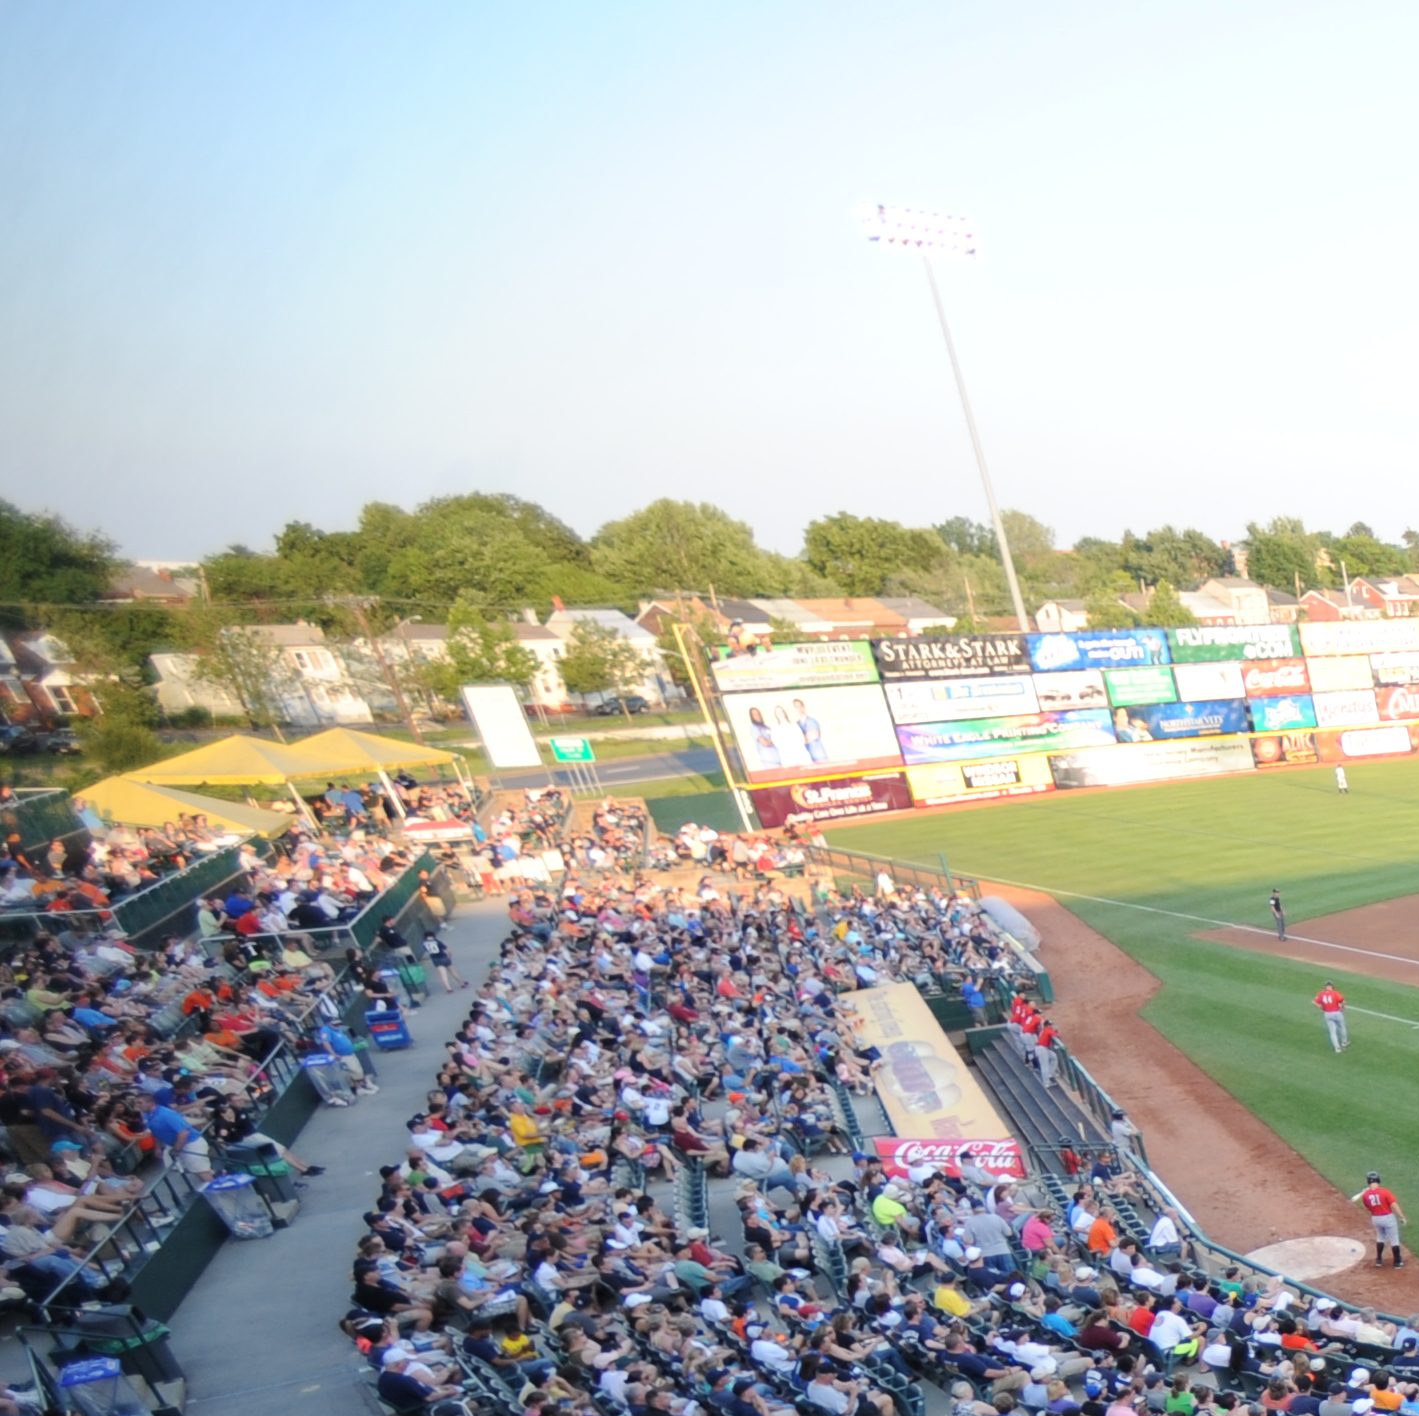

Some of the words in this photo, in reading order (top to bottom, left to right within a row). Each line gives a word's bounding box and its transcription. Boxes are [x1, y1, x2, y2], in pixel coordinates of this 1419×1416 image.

[902, 657, 966, 669] ATTORNEYS
[971, 656, 983, 666] AT
[987, 656, 1008, 666] LAW
[911, 735, 950, 746] WHITE
[953, 731, 990, 743] EAGLE
[993, 726, 1046, 739] PRINTING
[1050, 721, 1104, 734] COMPANY
[1165, 749, 1188, 758] Jersey
[1190, 743, 1245, 754] Manufacturers
[1184, 755, 1219, 764] Company
[963, 761, 1018, 777] WINDSOR
[972, 774, 1016, 787] NISSAN
[894, 1140, 1017, 1169] Coca-Cola
[1368, 1193, 1381, 1206] 21
